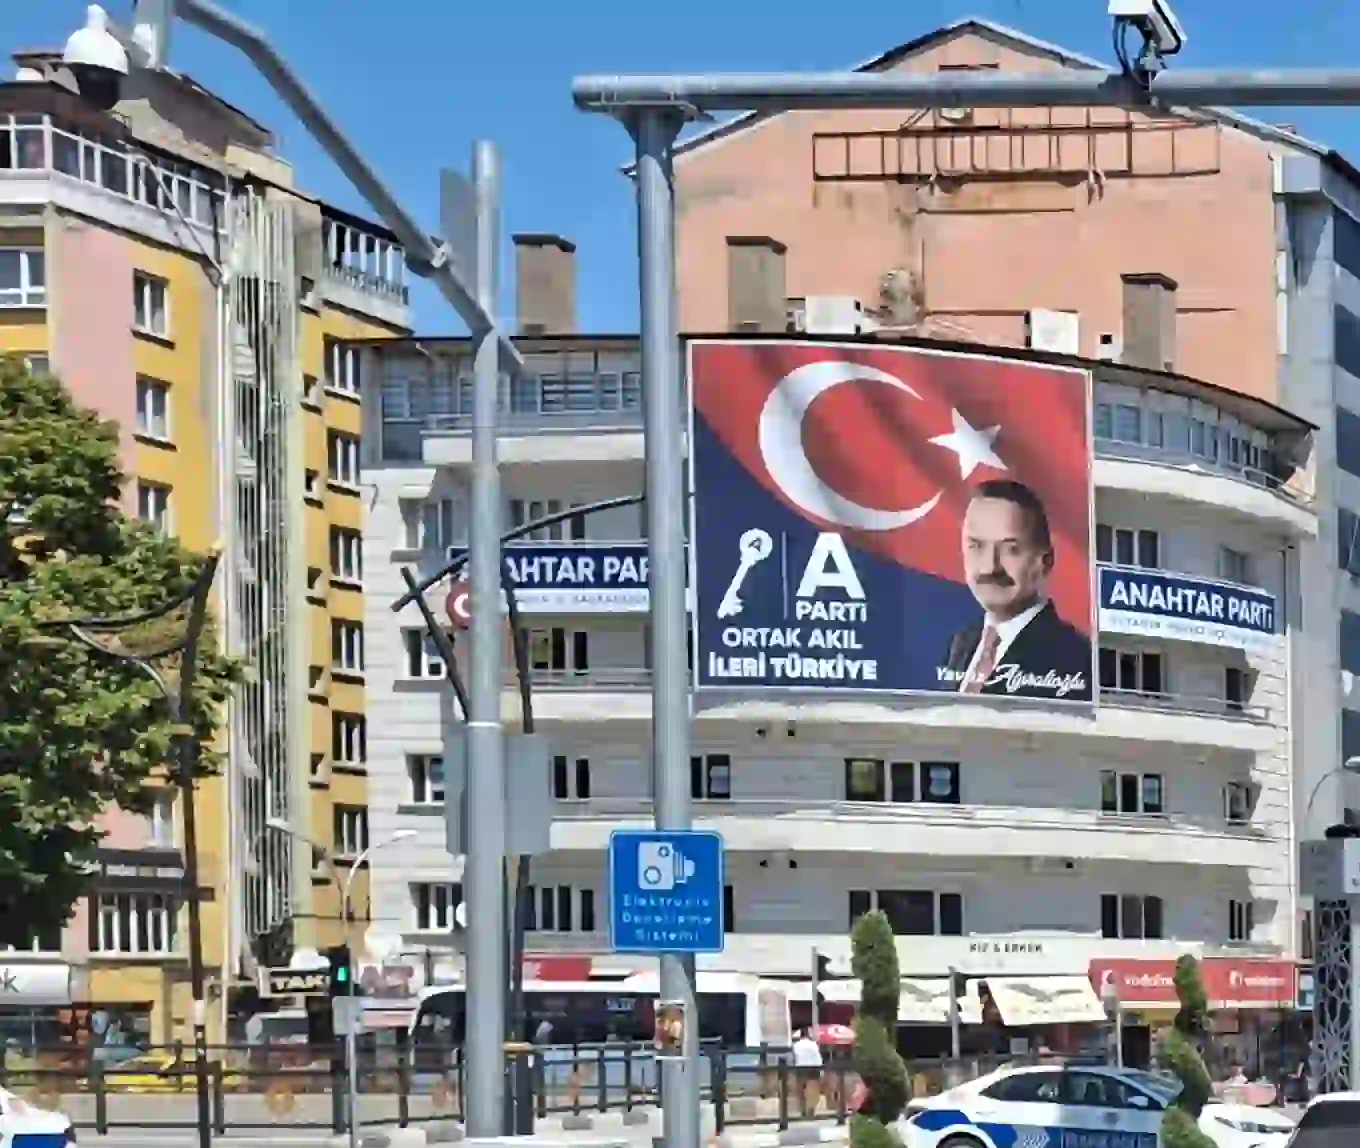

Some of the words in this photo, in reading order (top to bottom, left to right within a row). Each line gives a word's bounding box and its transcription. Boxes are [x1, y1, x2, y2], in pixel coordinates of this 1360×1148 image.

[796, 532, 866, 599] A
[1110, 579, 1225, 619] ANAHTAR
[722, 627, 802, 648] ORTAK
[808, 628, 862, 649] AKIL
[709, 651, 766, 677] İLERİ
[770, 652, 877, 680] TÜRKİYE
